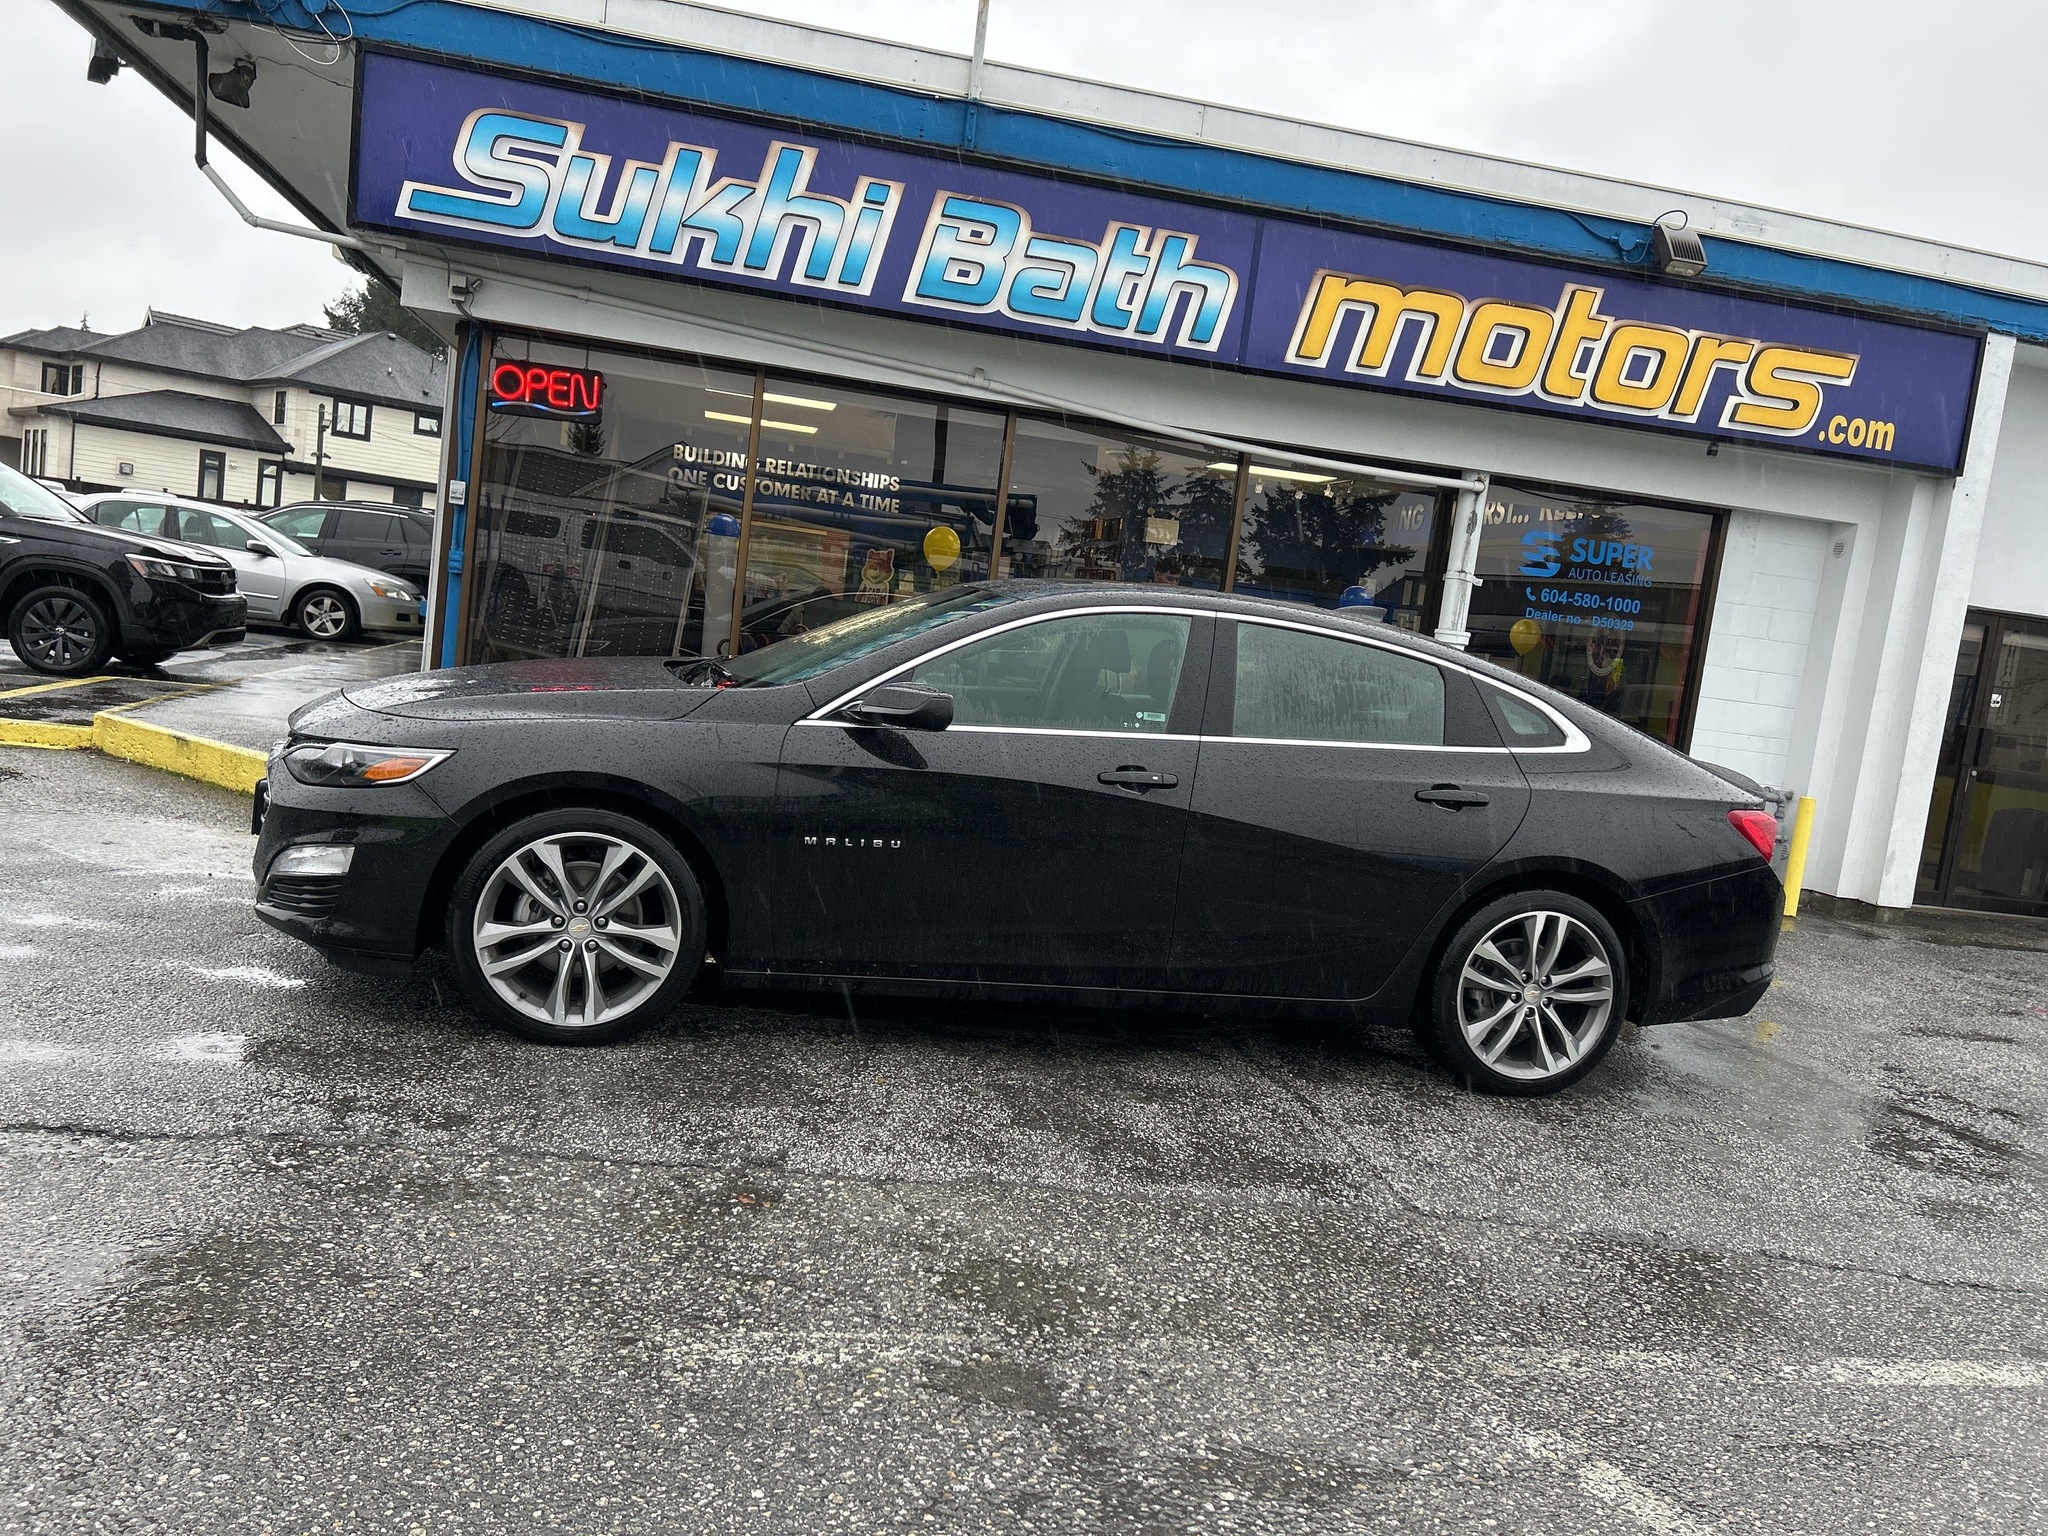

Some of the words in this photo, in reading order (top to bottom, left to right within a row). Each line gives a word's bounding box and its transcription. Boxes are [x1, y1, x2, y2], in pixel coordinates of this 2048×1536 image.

[395, 107, 906, 297] Sukhi
[901, 189, 1239, 352] Bath
[1284, 267, 1861, 437] motors
[1819, 415, 1895, 451] .com
[493, 364, 599, 410] OPEN
[668, 467, 708, 486] ONE
[713, 473, 811, 501] CUSTOMER
[815, 488, 839, 504] AT
[842, 492, 855, 507] A
[860, 493, 900, 513] TIME
[765, 458, 901, 492] RELATIONSHIPS
[1569, 537, 1653, 571] SUPER
[1568, 567, 1601, 581] AUTO
[1604, 571, 1652, 588] LEASING
[1540, 588, 1641, 614] 604-580-1000
[1525, 607, 1564, 622] Dealer
[1566, 615, 1581, 625] no
[1591, 616, 1634, 631] D50329
[804, 836, 901, 848] MALIBU
